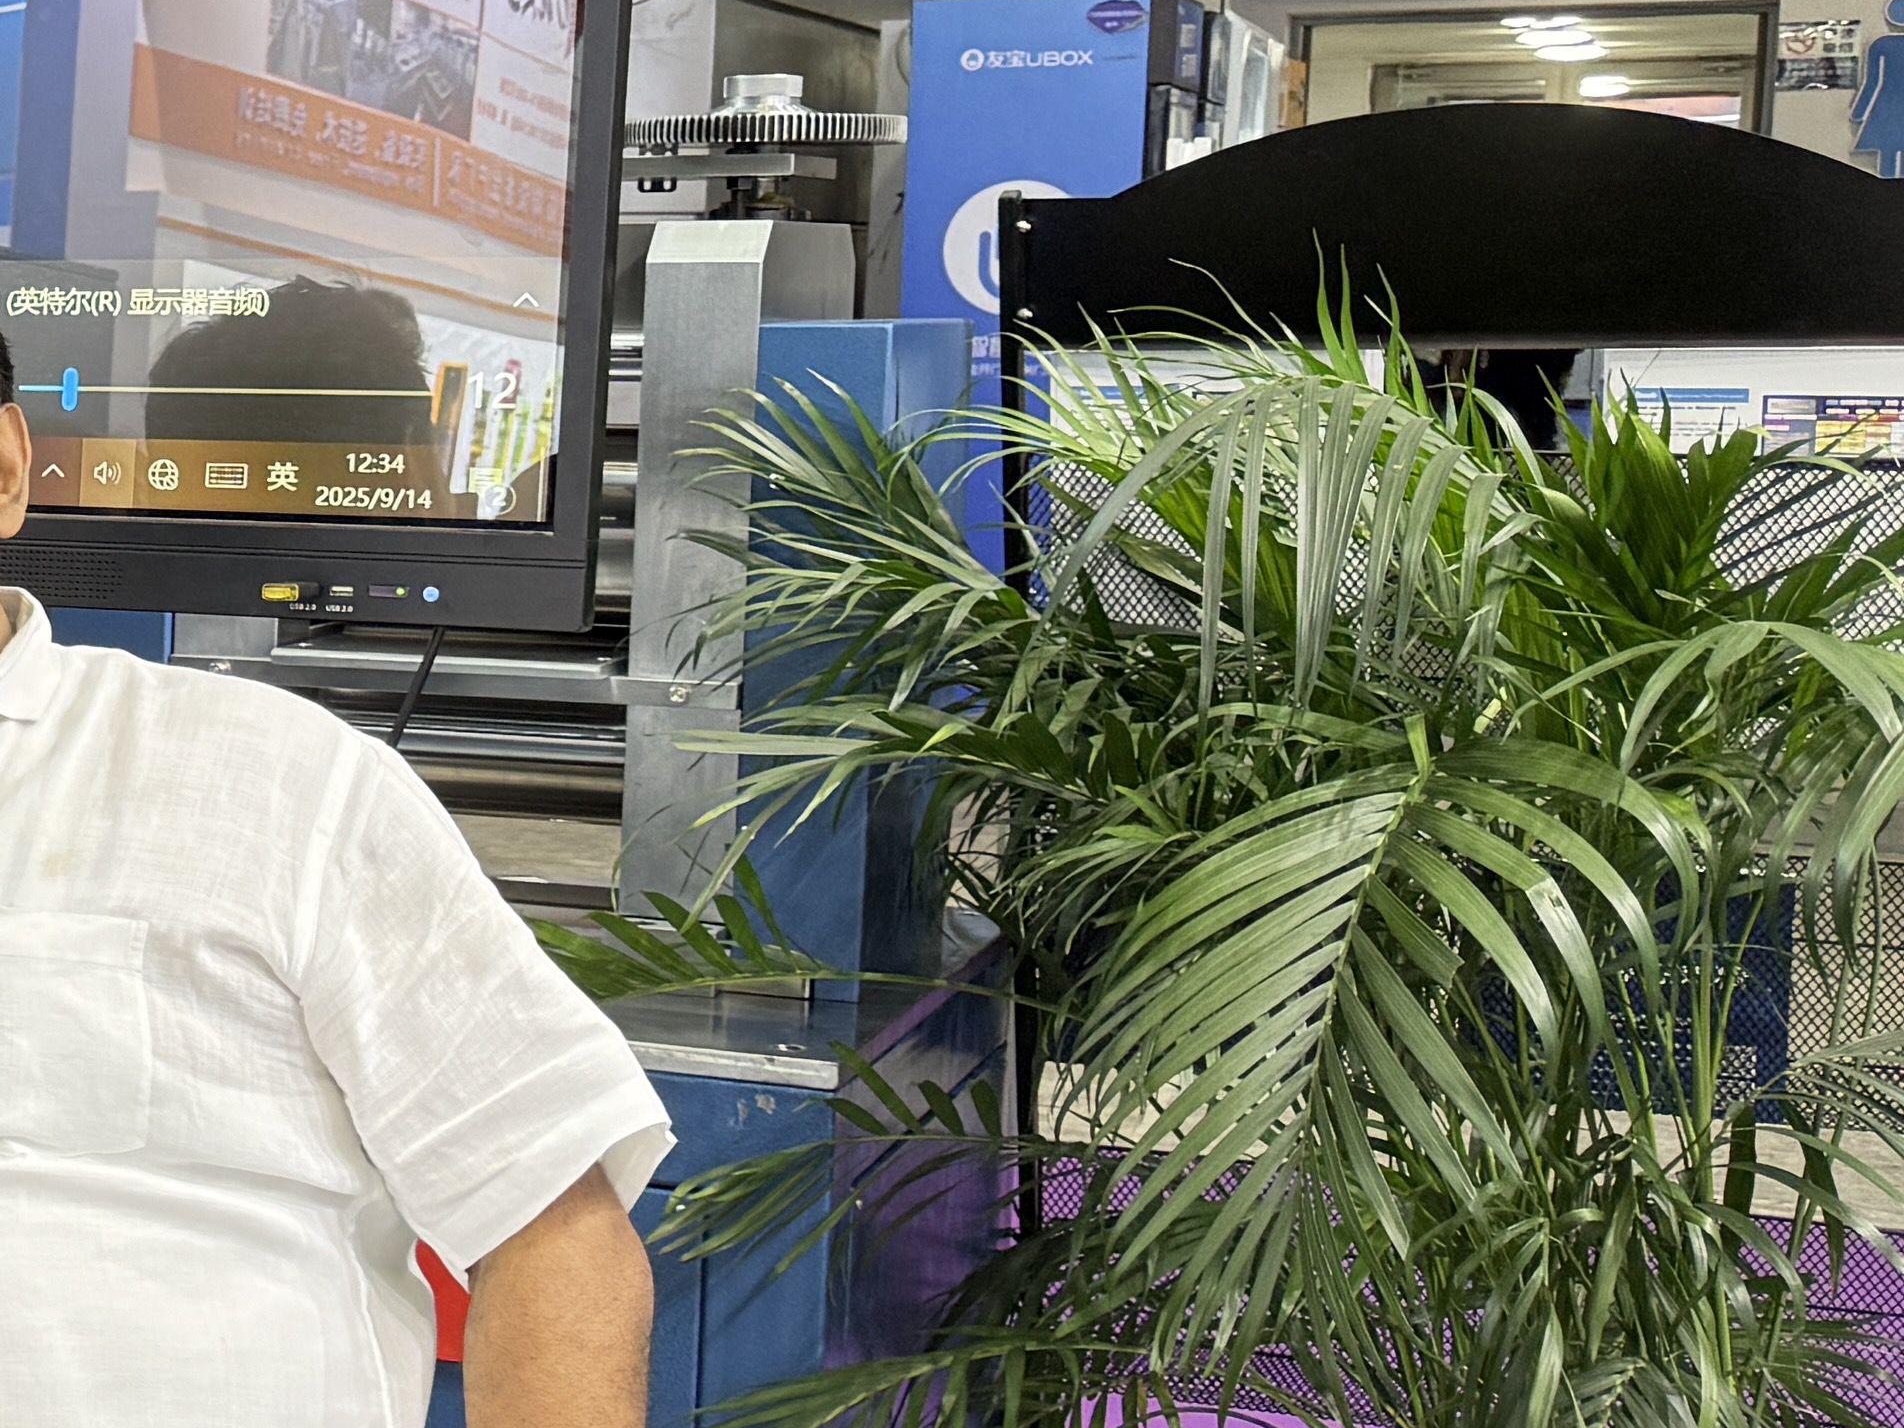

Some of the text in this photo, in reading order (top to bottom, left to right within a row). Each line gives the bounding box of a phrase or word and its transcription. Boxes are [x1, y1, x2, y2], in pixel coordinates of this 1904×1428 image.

[6, 286, 122, 317] (英特尔(R)
[128, 286, 271, 317] 显示器音频)
[468, 371, 518, 410] 12
[267, 461, 300, 492] 英
[345, 452, 406, 475] 12:34
[314, 486, 432, 511] 2025/9/14
